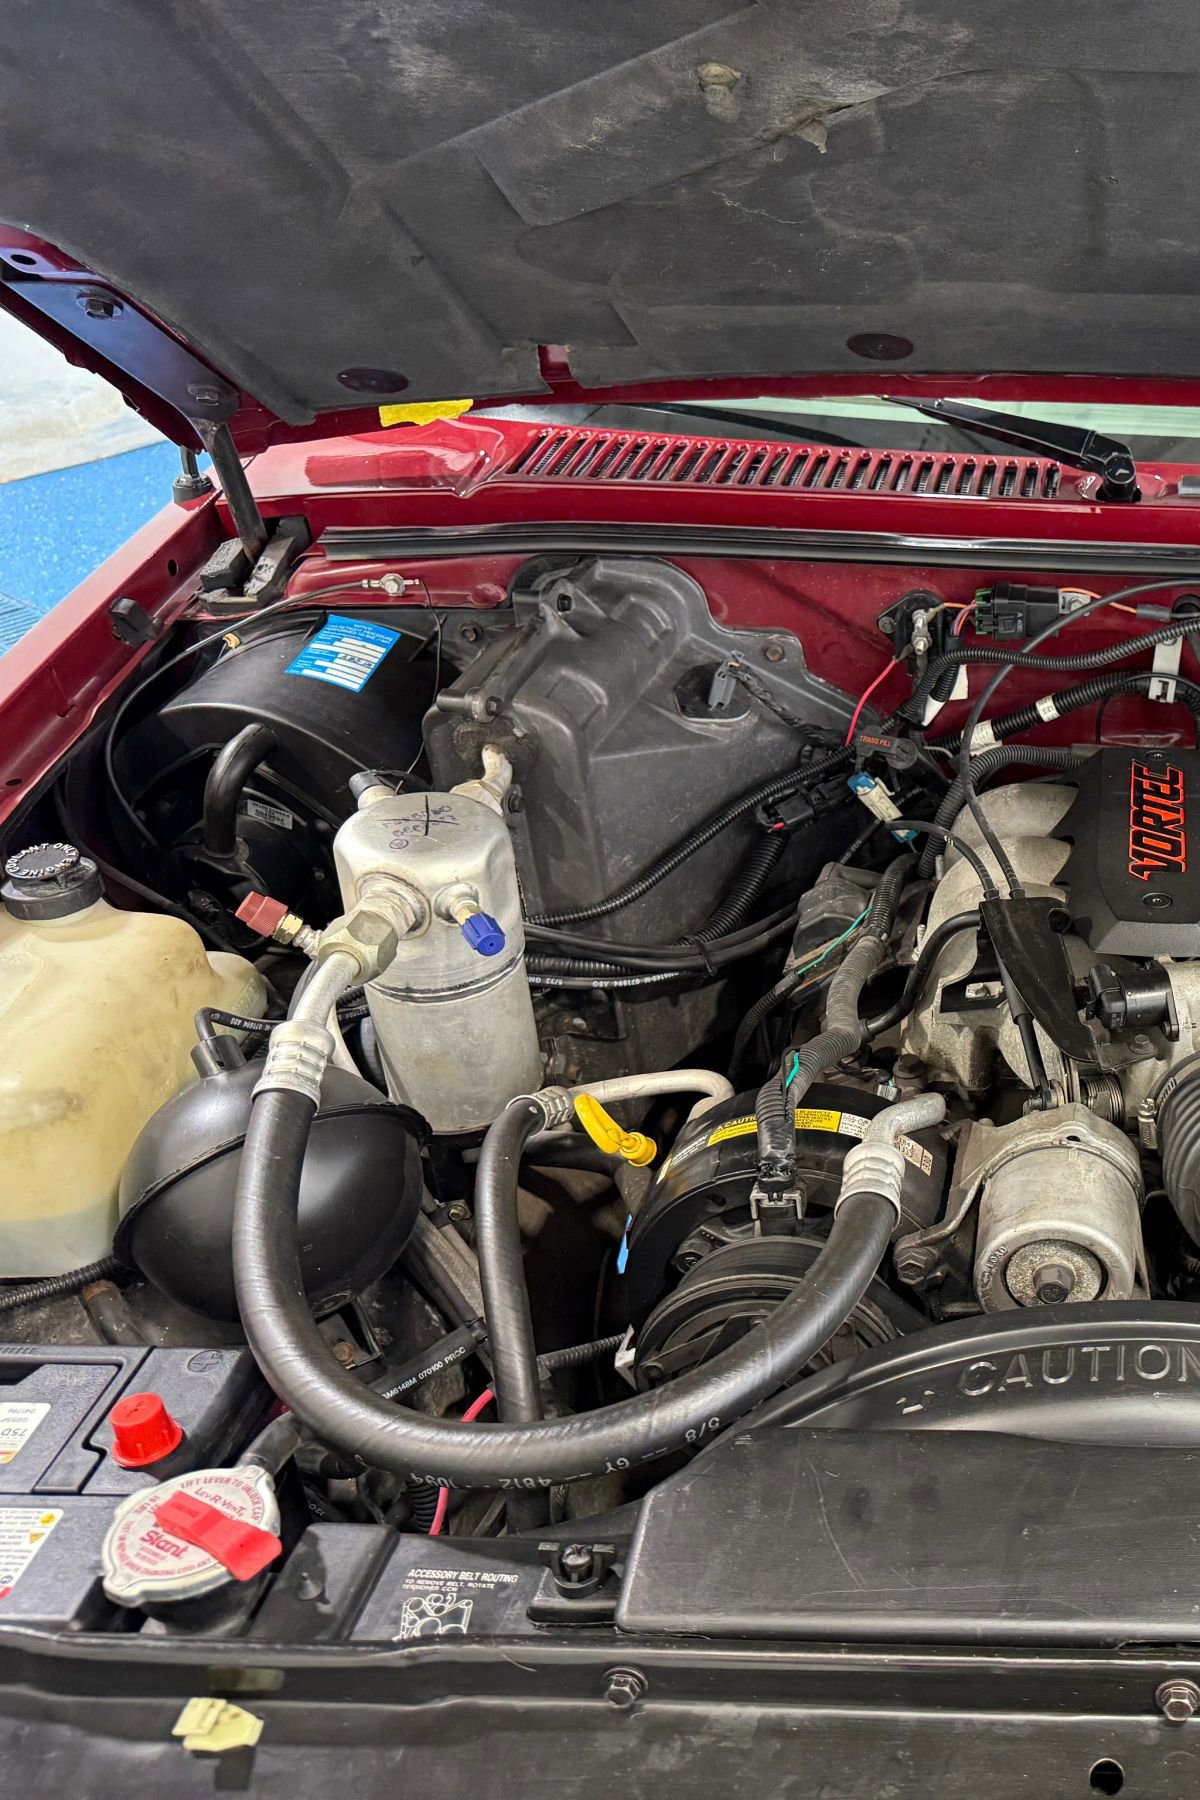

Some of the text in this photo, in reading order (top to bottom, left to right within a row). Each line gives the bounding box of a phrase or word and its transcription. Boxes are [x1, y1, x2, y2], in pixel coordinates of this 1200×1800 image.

[1128, 759, 1186, 881] VORTEC
[418, 1360, 444, 1380] 070100
[684, 1416, 721, 1443] 5/8
[203, 1475, 230, 1485] LEVER
[139, 1529, 190, 1558] Stant
[408, 1568, 519, 1583] ACCESSORY BELT ROUTING
[416, 1579, 445, 1587] REMOVE
